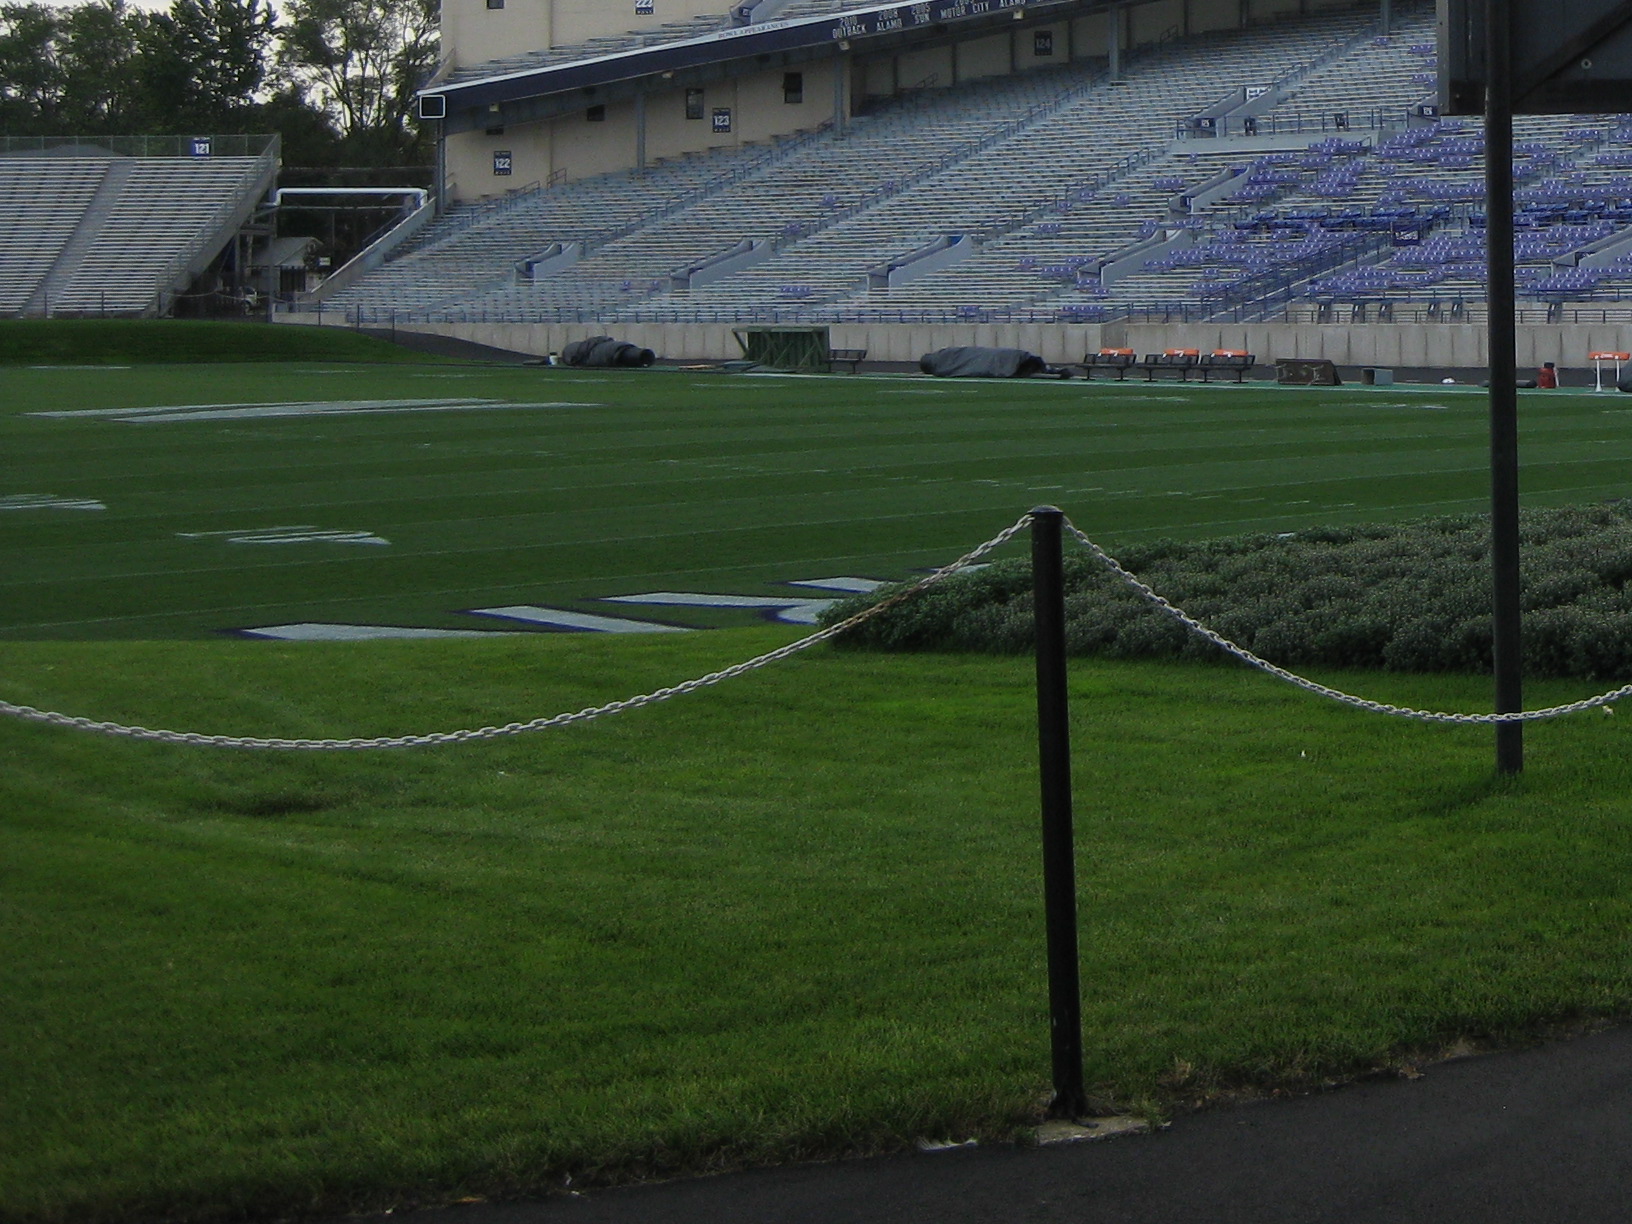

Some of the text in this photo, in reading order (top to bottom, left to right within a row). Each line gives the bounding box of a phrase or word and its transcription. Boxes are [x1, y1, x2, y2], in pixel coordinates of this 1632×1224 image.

[940, 1, 989, 19] MOTOR CITY
[876, 18, 902, 32] ALAMO
[832, 24, 866, 39] OUTBACK
[1036, 38, 1051, 49] 124
[714, 115, 730, 126] 123
[195, 143, 210, 154] 121
[494, 158, 511, 169] 122
